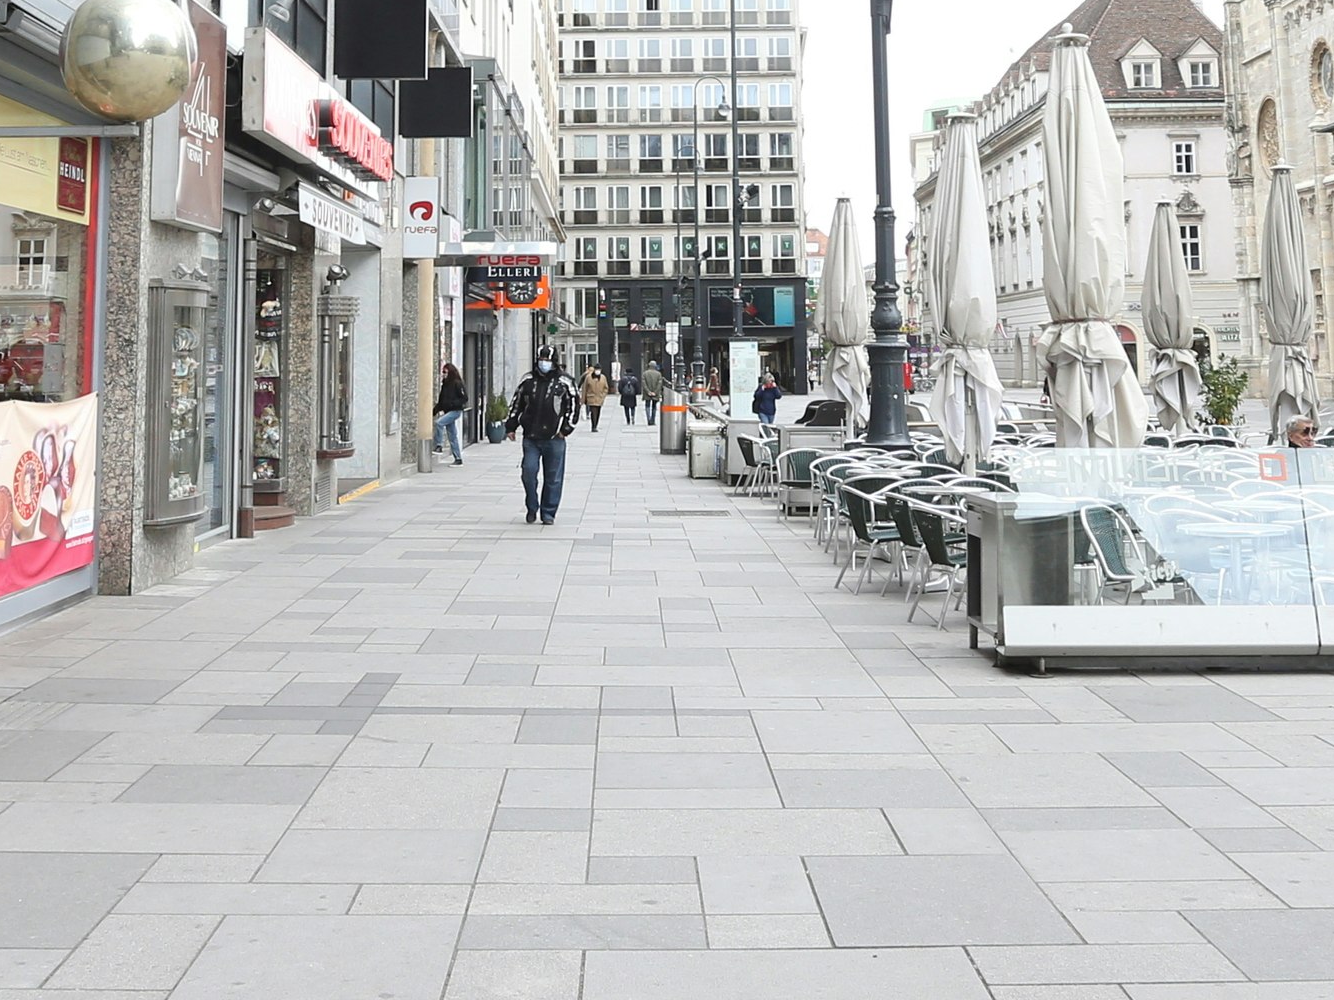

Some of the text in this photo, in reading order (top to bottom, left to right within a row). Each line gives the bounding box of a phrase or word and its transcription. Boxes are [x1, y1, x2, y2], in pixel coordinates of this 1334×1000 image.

[330, 99, 394, 182] SOUVENIRS
[59, 161, 85, 183] HEINDL
[404, 226, 438, 234] ruefa
[477, 254, 540, 266] ruefa
